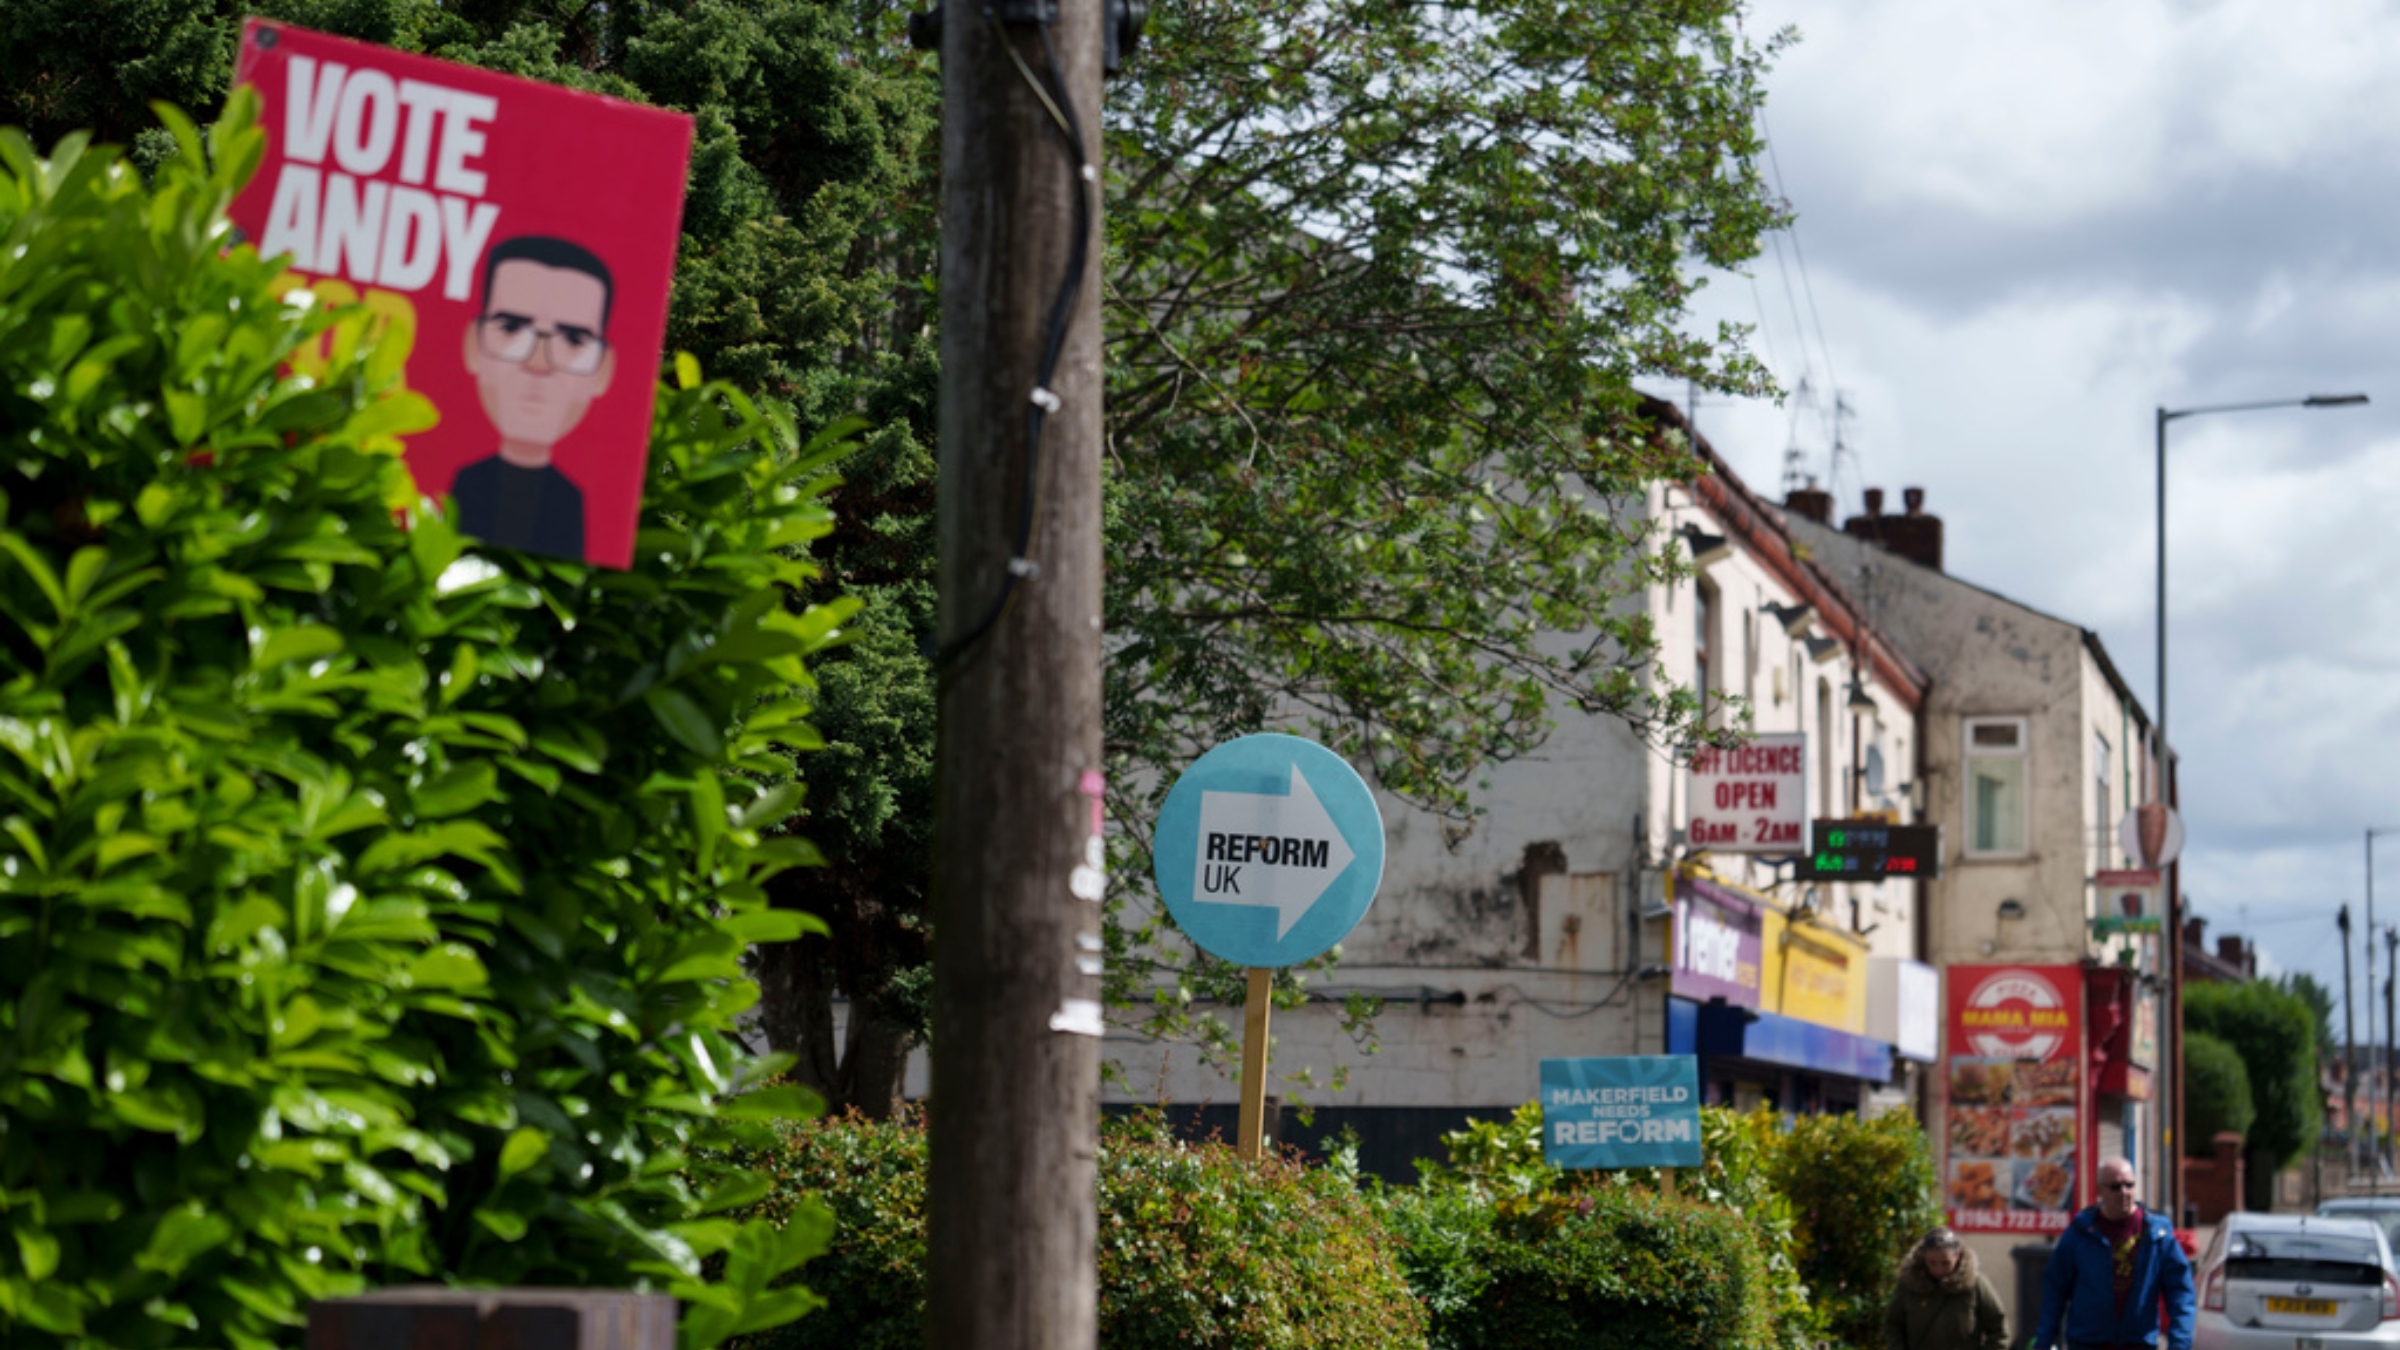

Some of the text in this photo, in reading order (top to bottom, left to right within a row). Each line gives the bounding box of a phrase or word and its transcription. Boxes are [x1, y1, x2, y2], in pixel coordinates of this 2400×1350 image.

[284, 54, 499, 197] VOTE
[260, 163, 500, 301] ANDY
[1727, 745, 1801, 774] LICENCE
[1715, 781, 1776, 811] OPEN
[1690, 817, 1737, 845] 6AM
[1755, 817, 1800, 843] 2AM
[1206, 832, 1329, 869] REFORM
[1204, 864, 1241, 894] UK
[1962, 1009, 2069, 1026] MAMA MIA
[1553, 1086, 1688, 1105] MAKERFIELD
[1592, 1105, 1651, 1118] NEEDS
[1555, 1119, 1690, 1144] REFORM
